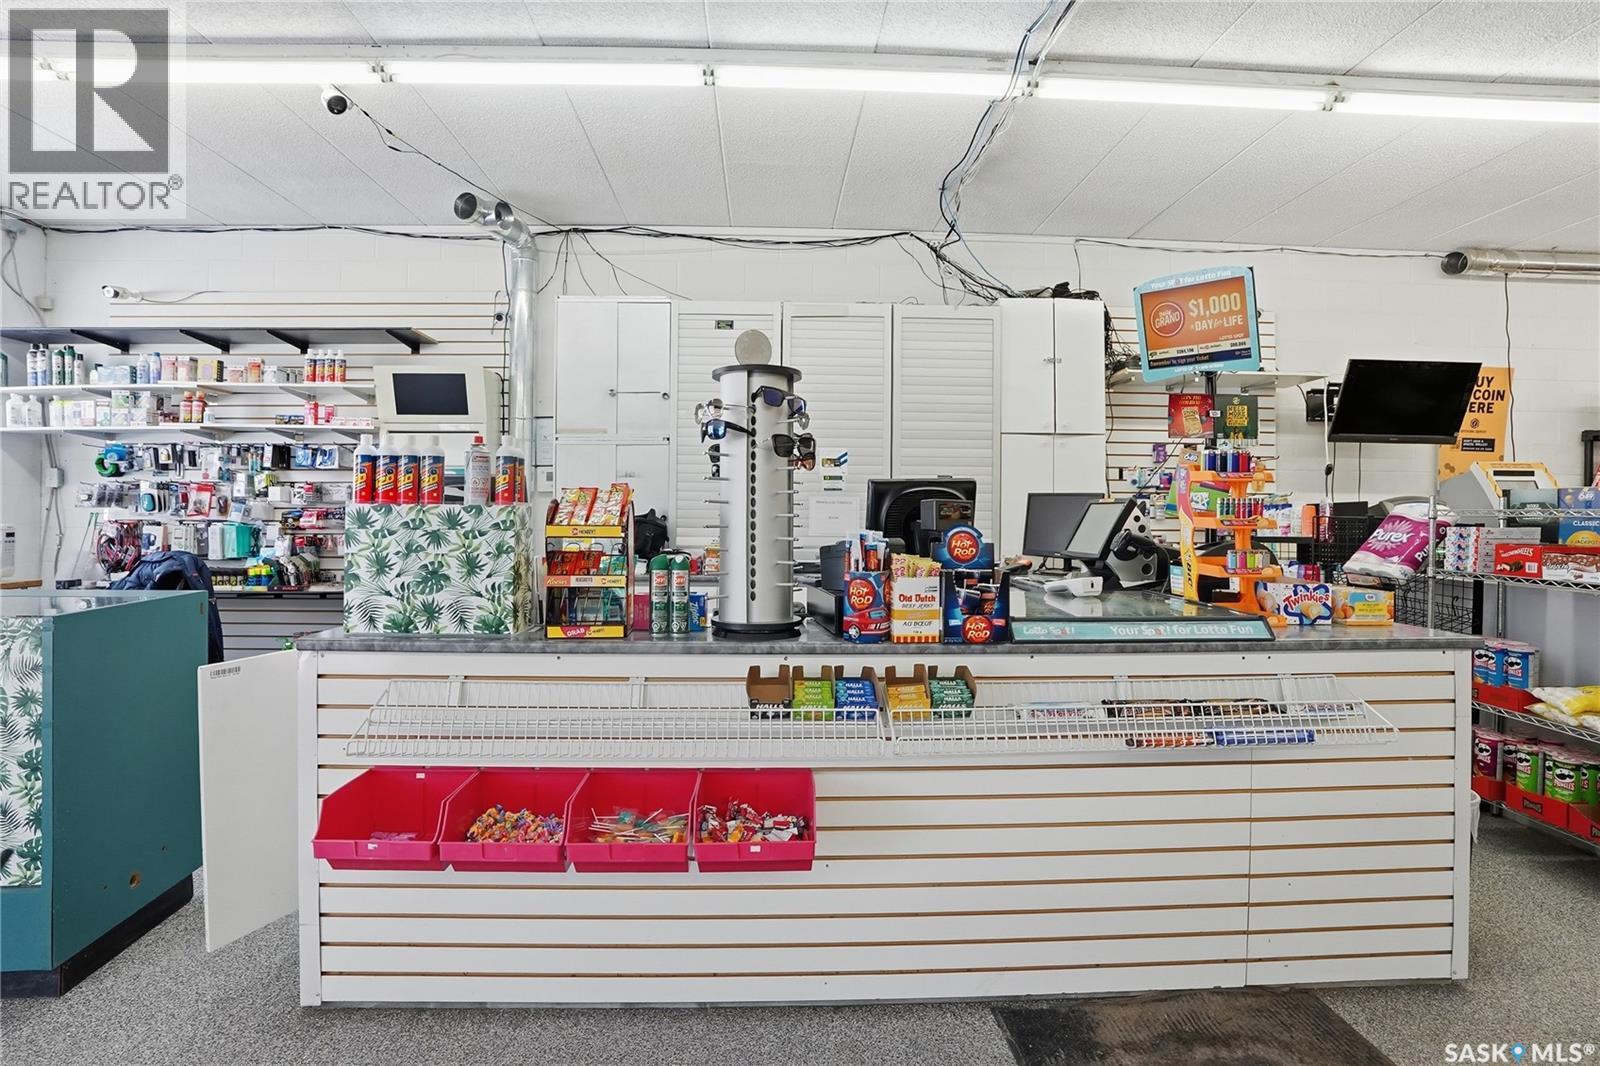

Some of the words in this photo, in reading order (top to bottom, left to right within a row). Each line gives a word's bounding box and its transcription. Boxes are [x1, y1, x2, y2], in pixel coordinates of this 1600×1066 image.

[1188, 292, 1241, 318] $1,000
[1154, 311, 1181, 329] GRAND
[1195, 319, 1214, 331] DAY
[1223, 314, 1244, 327] LIFE
[1475, 376, 1495, 388] UY
[1468, 402, 1495, 413] ERE
[1369, 528, 1416, 543] Purex
[1185, 562, 1193, 590] BIC
[898, 593, 913, 603] Old
[914, 593, 936, 603] Dutch
[1283, 590, 1330, 611] Twinkies
[1023, 625, 1048, 635] Lotto
[1109, 625, 1140, 636] Your
[1172, 625, 1193, 635] for
[1193, 624, 1229, 635] Lotto
[1229, 624, 1254, 635] Fun
